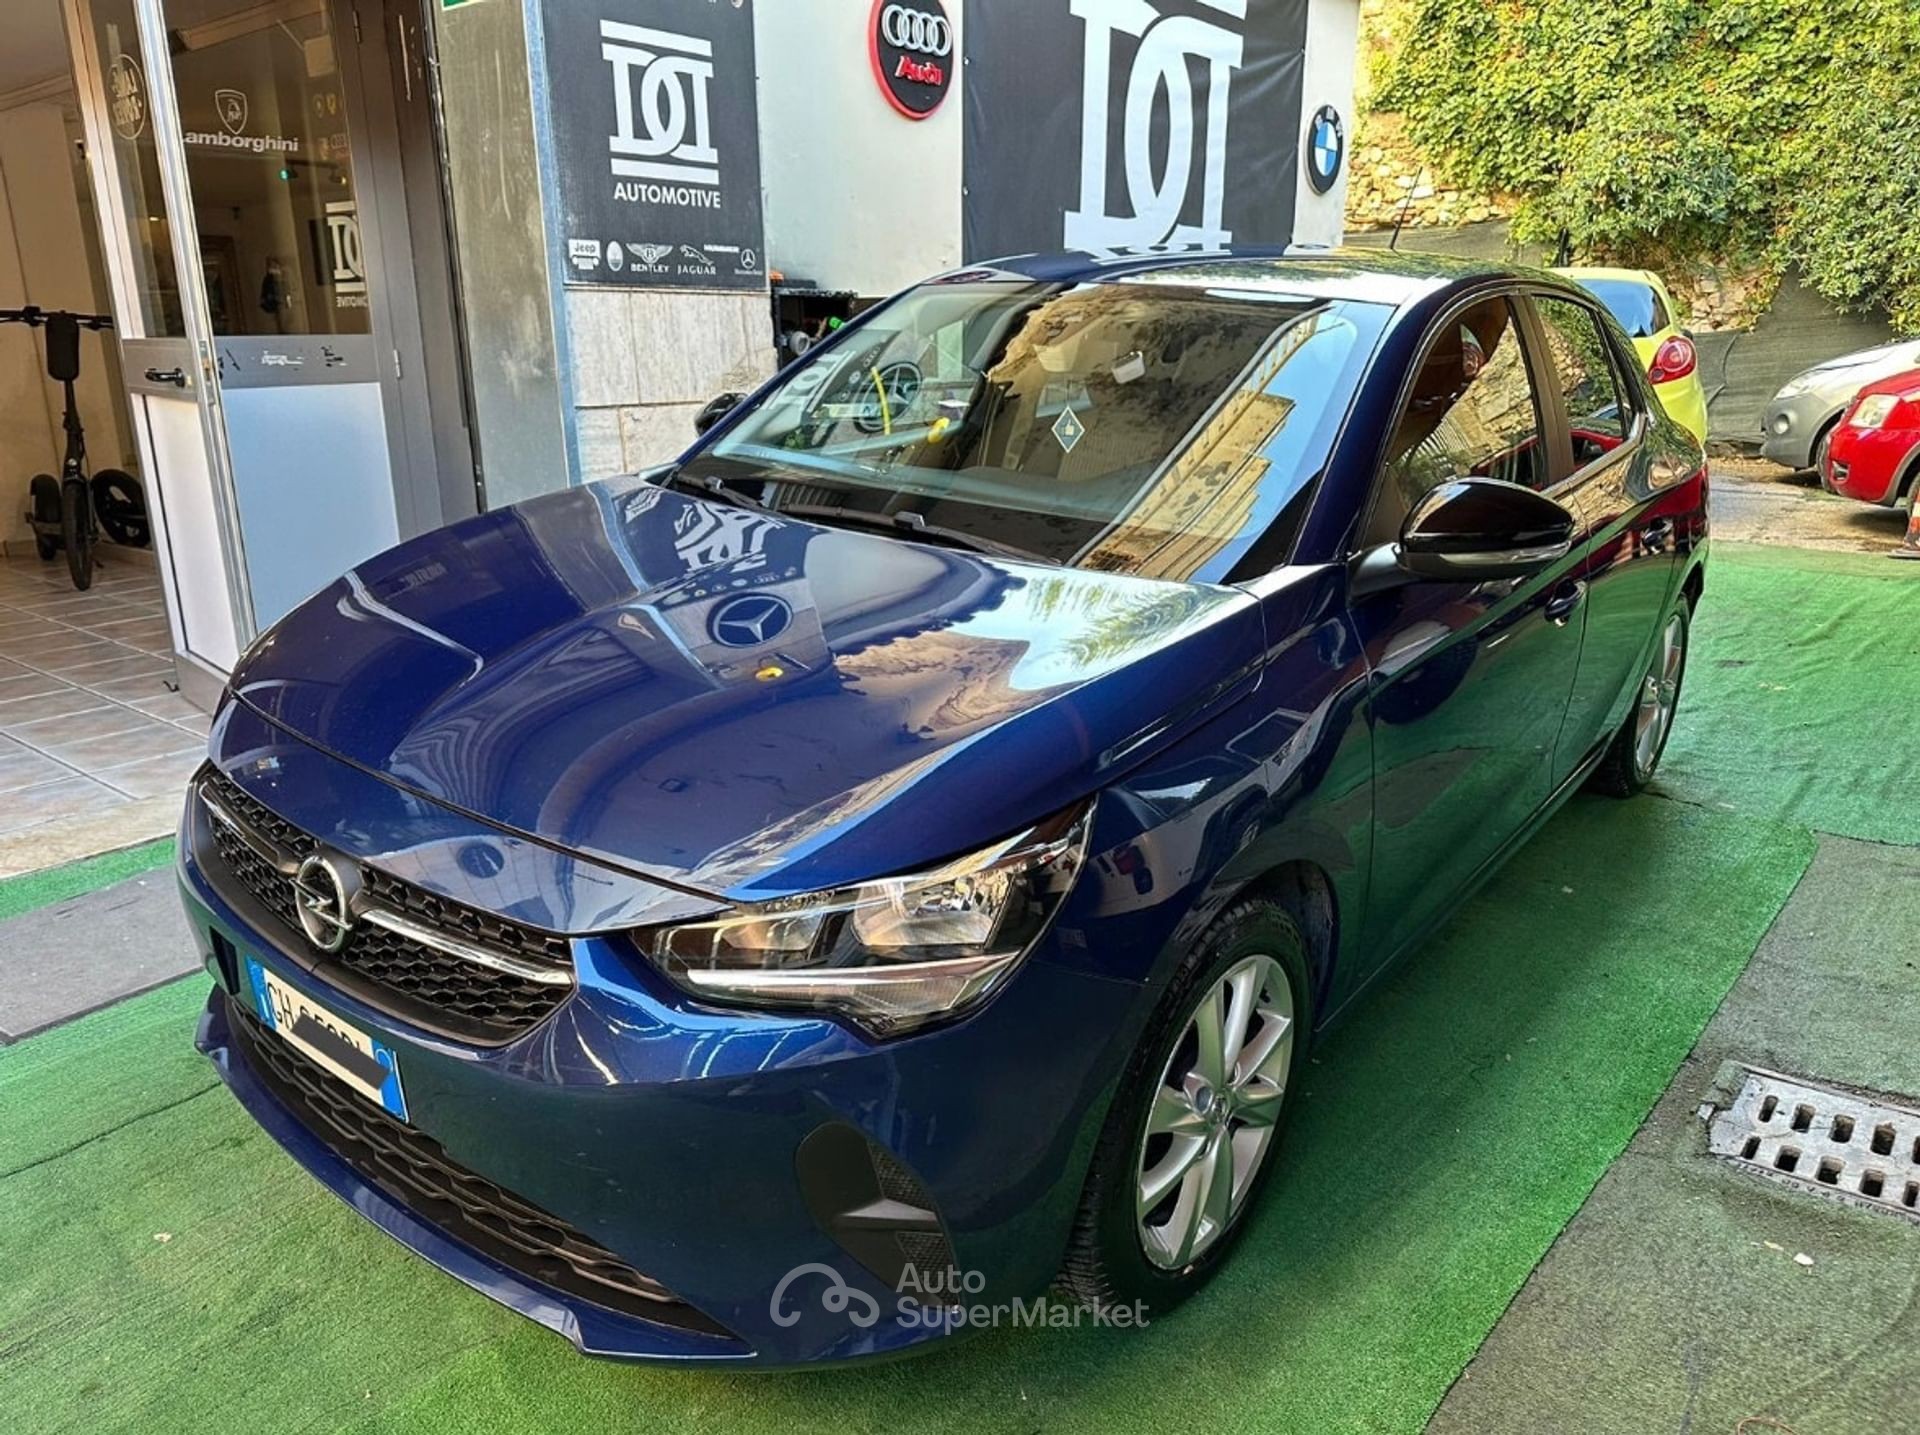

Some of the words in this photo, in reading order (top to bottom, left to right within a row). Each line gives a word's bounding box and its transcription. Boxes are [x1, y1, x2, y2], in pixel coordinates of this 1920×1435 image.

[894, 55, 944, 86] Audi
[182, 131, 299, 153] amborghini
[613, 182, 721, 209] AUTOMOTIVE
[574, 242, 596, 255] Jeep
[630, 263, 670, 273] BENTLEY
[677, 264, 717, 275] JAGUAR
